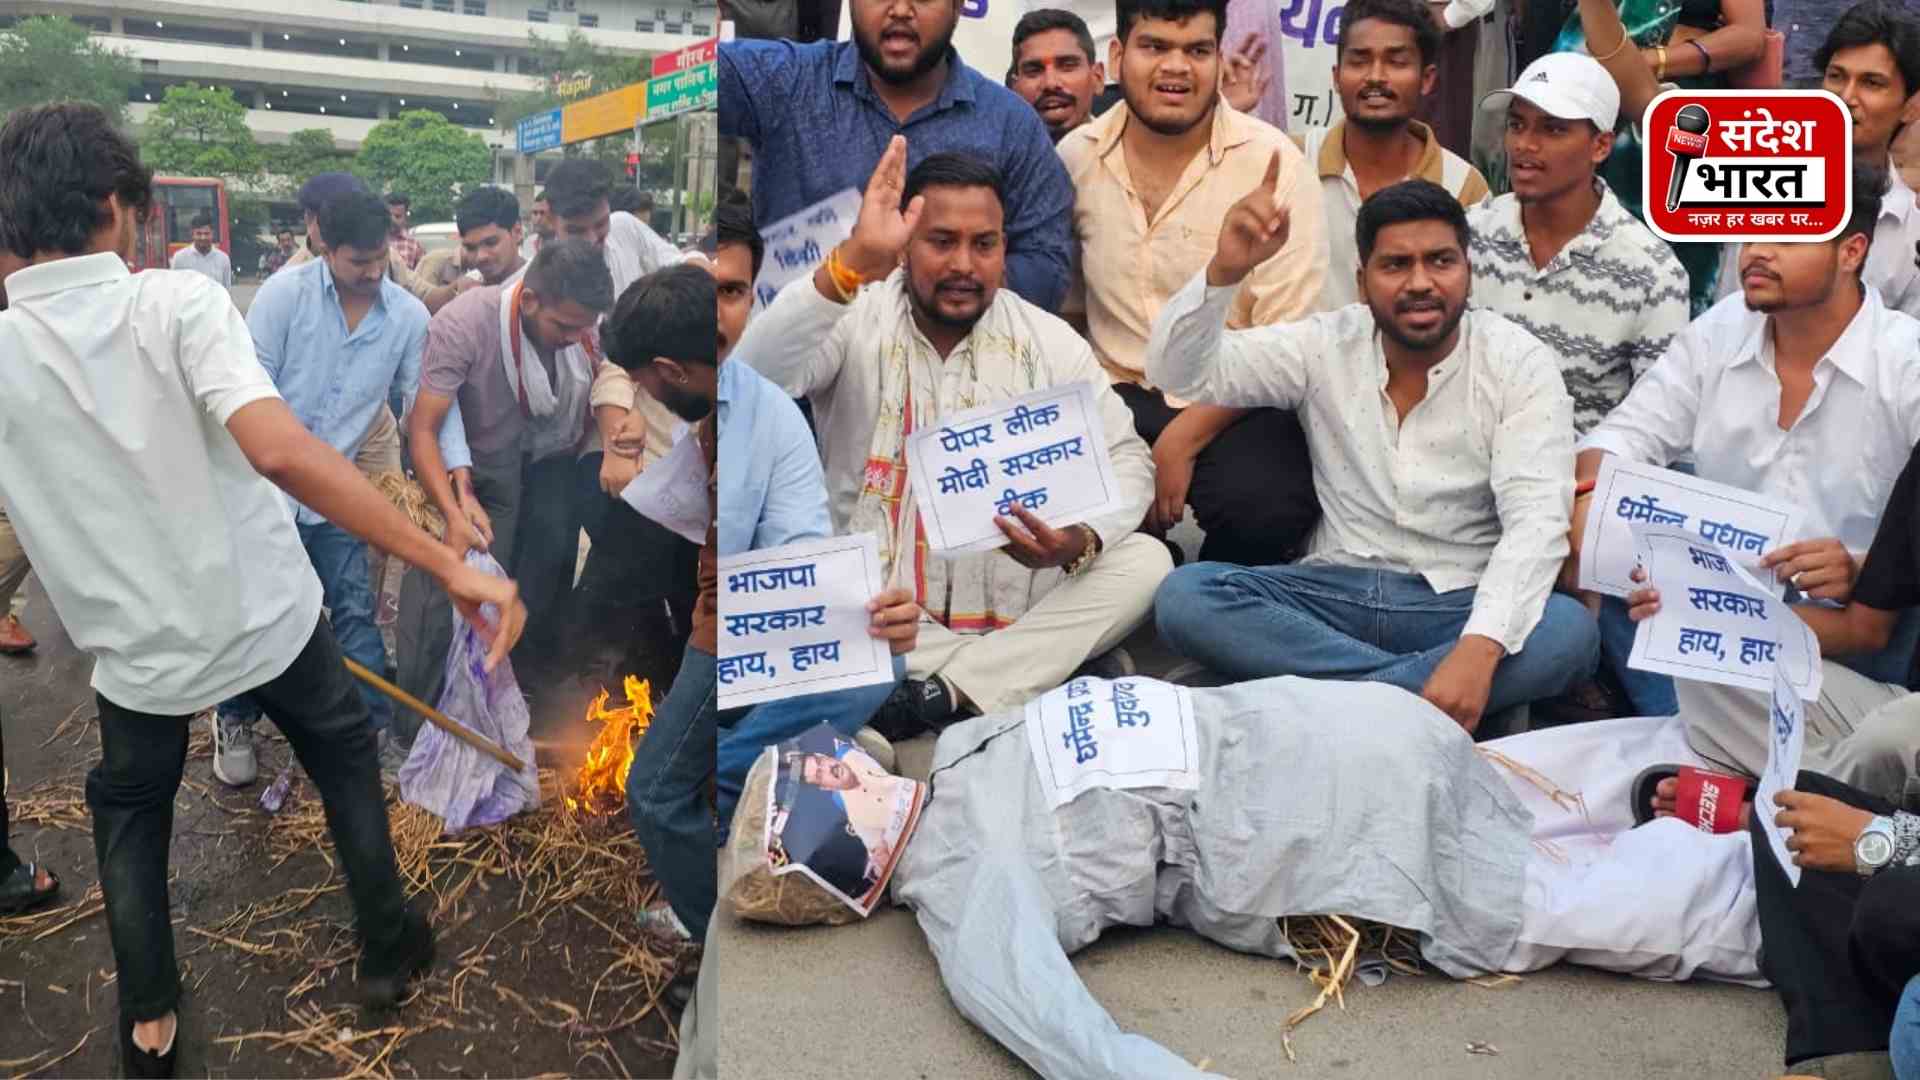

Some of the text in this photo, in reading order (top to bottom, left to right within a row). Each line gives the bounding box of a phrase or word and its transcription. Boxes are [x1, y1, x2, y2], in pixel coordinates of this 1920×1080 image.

[939, 403, 1060, 453] पेपर लीक
[937, 436, 1084, 495] मोदी सरकार
[728, 563, 816, 593] भाजपा
[724, 605, 825, 636] सरकार
[1688, 587, 1768, 620] सरकार
[1678, 627, 1727, 661] हाय,
[718, 640, 841, 684] हाय, हाय
